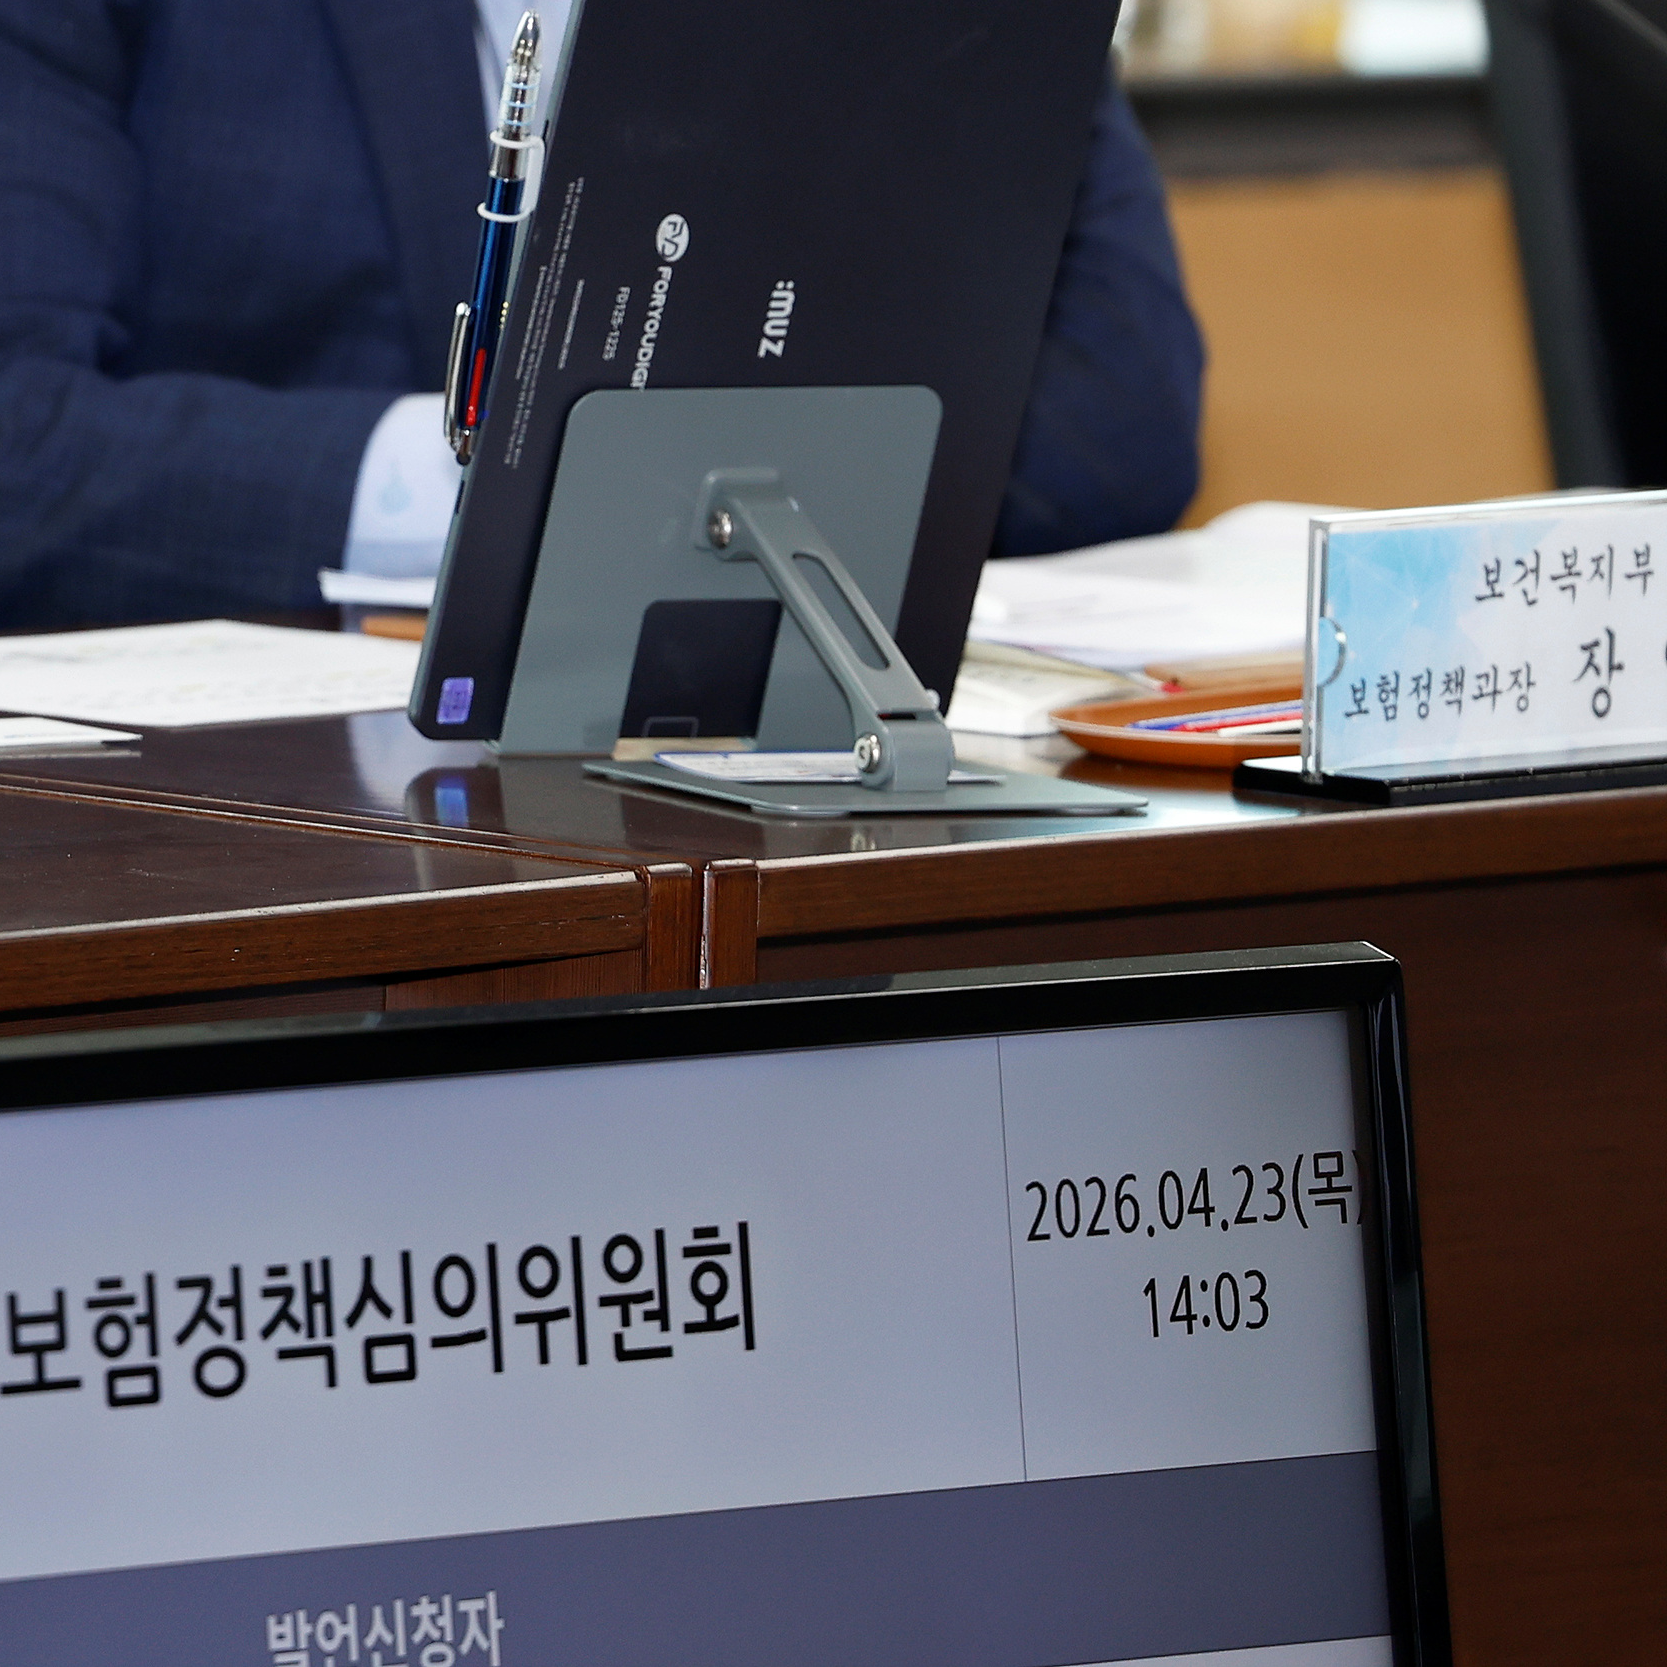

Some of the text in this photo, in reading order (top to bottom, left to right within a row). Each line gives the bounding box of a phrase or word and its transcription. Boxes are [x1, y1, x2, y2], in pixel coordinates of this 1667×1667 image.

[630, 265, 673, 392] FORYOUDIGI
[1475, 542, 1656, 607] 보건복지부
[1344, 627, 1625, 722] 보험정책과장 장
[1024, 1149, 1364, 1242] 2026.04.23(목)
[1142, 1269, 1270, 1338] 14:03
